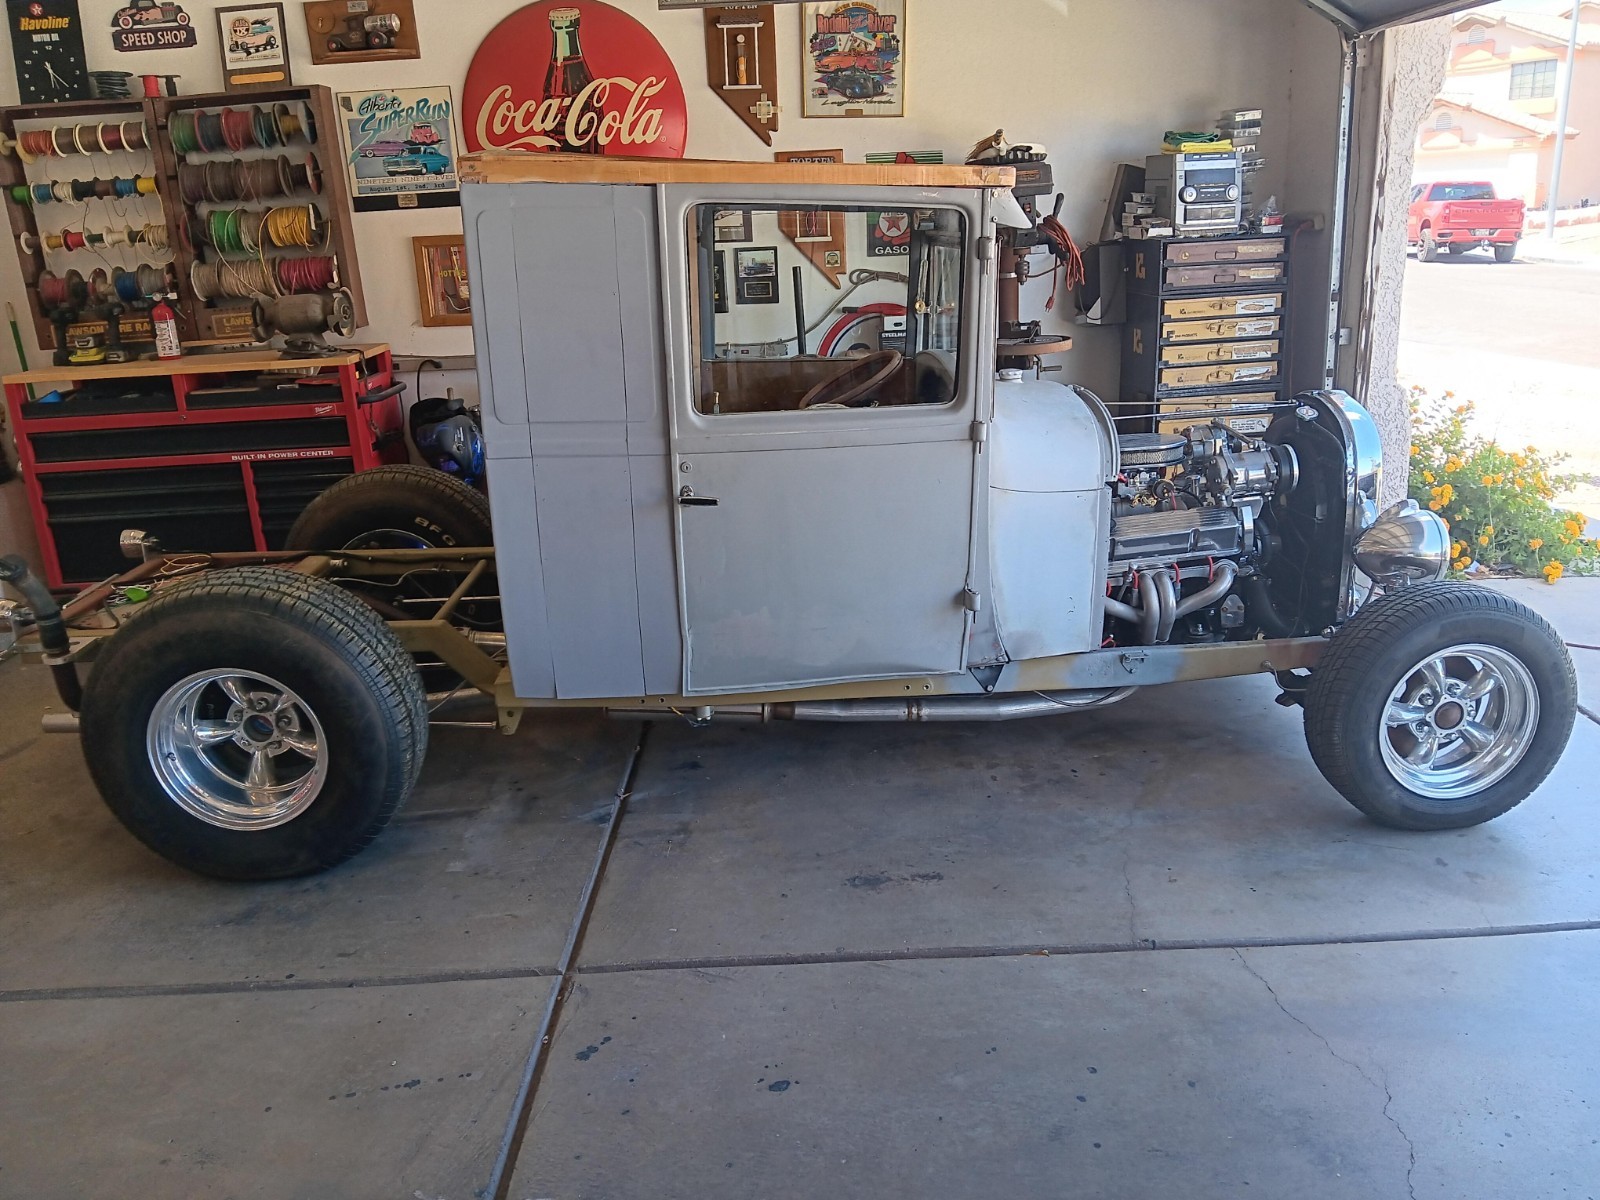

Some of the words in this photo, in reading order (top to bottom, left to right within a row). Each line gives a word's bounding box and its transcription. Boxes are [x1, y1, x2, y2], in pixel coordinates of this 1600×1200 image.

[20, 16, 70, 31] Havoline
[867, 12, 896, 33] River
[121, 32, 155, 47] SPEED
[157, 30, 187, 44] SHOP
[359, 95, 402, 116] Alberta
[475, 77, 667, 151] Coca-Cola
[357, 177, 397, 185] NINETEEN
[875, 246, 909, 254] GASO
[268, 451, 298, 459] POWER
